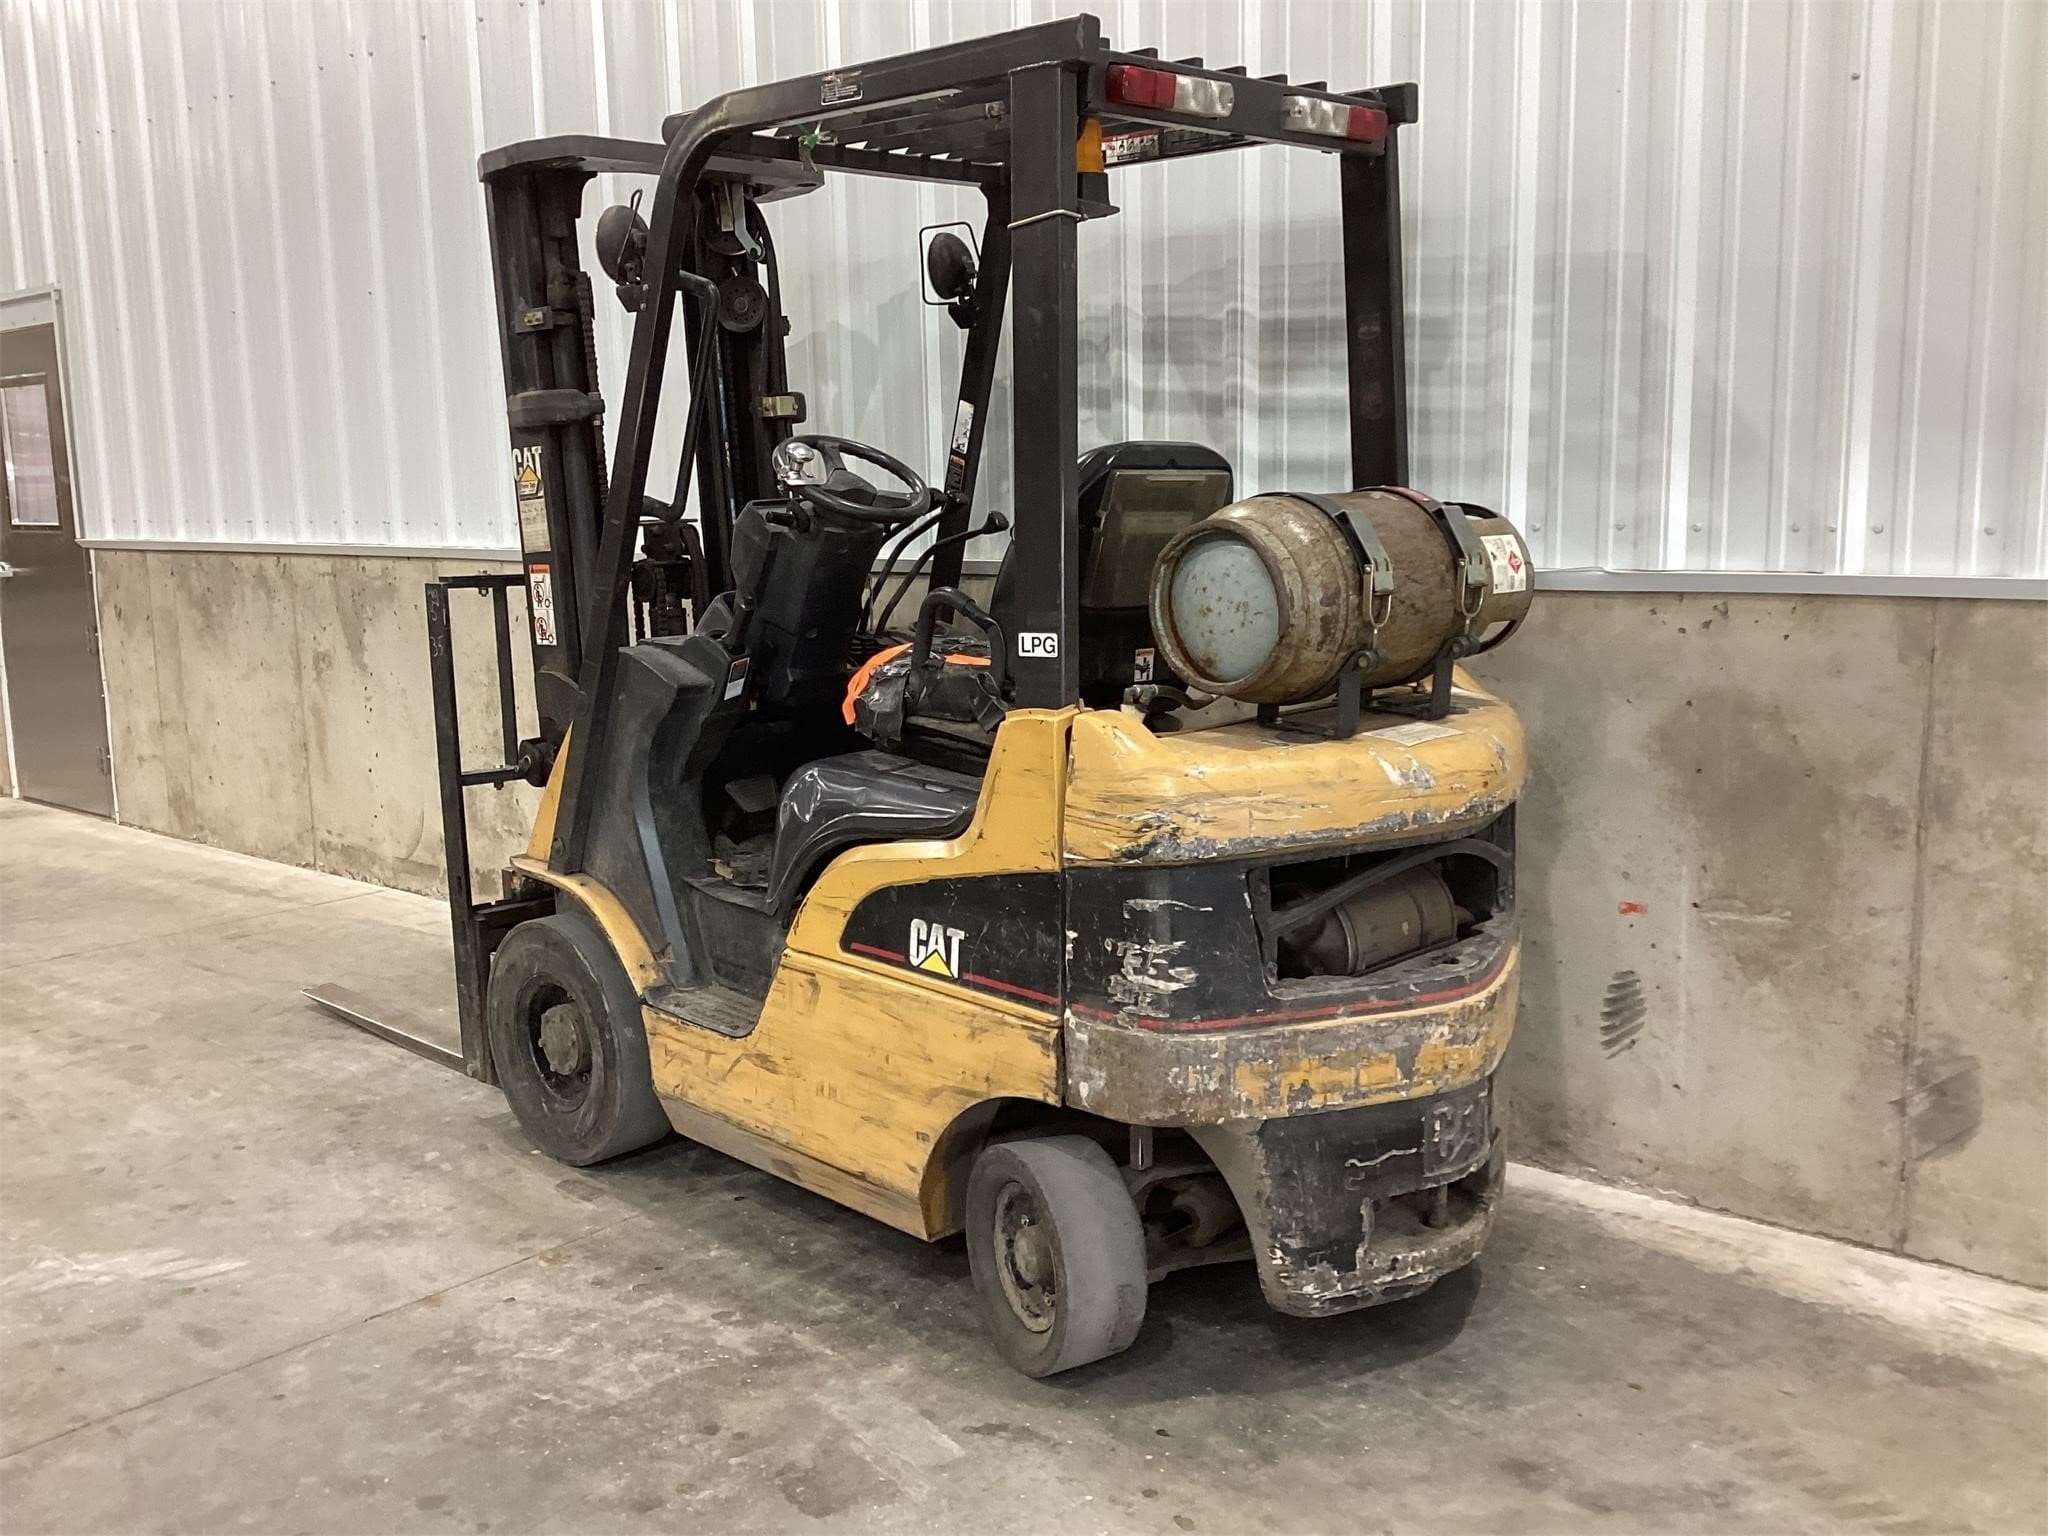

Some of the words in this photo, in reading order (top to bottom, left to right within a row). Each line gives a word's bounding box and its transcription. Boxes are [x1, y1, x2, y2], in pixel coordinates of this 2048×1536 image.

[512, 446, 542, 481] CAT
[1021, 636, 1055, 654] LPG
[909, 918, 965, 978] CAT
